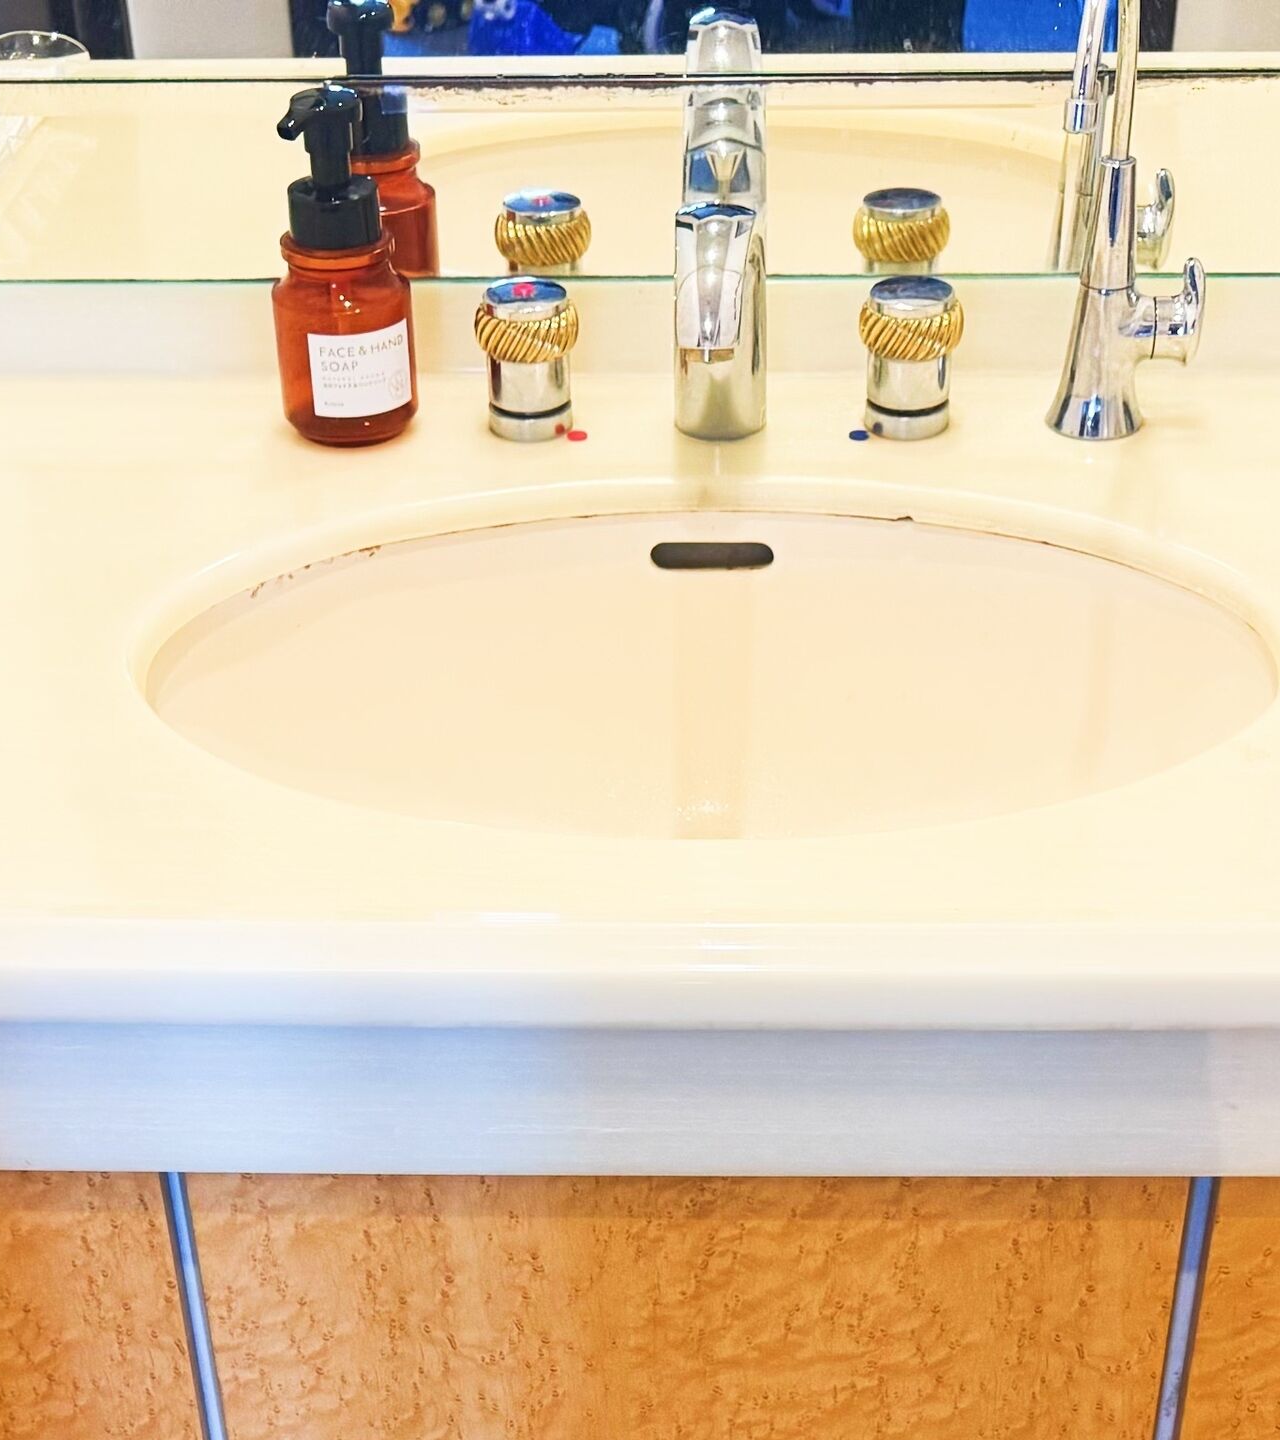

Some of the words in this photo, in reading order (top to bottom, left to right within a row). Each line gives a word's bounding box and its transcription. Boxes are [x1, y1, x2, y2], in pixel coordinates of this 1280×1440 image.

[319, 346, 355, 359] FACE
[357, 345, 368, 355] &
[370, 333, 404, 354] HAND
[321, 360, 359, 373] SOAP
